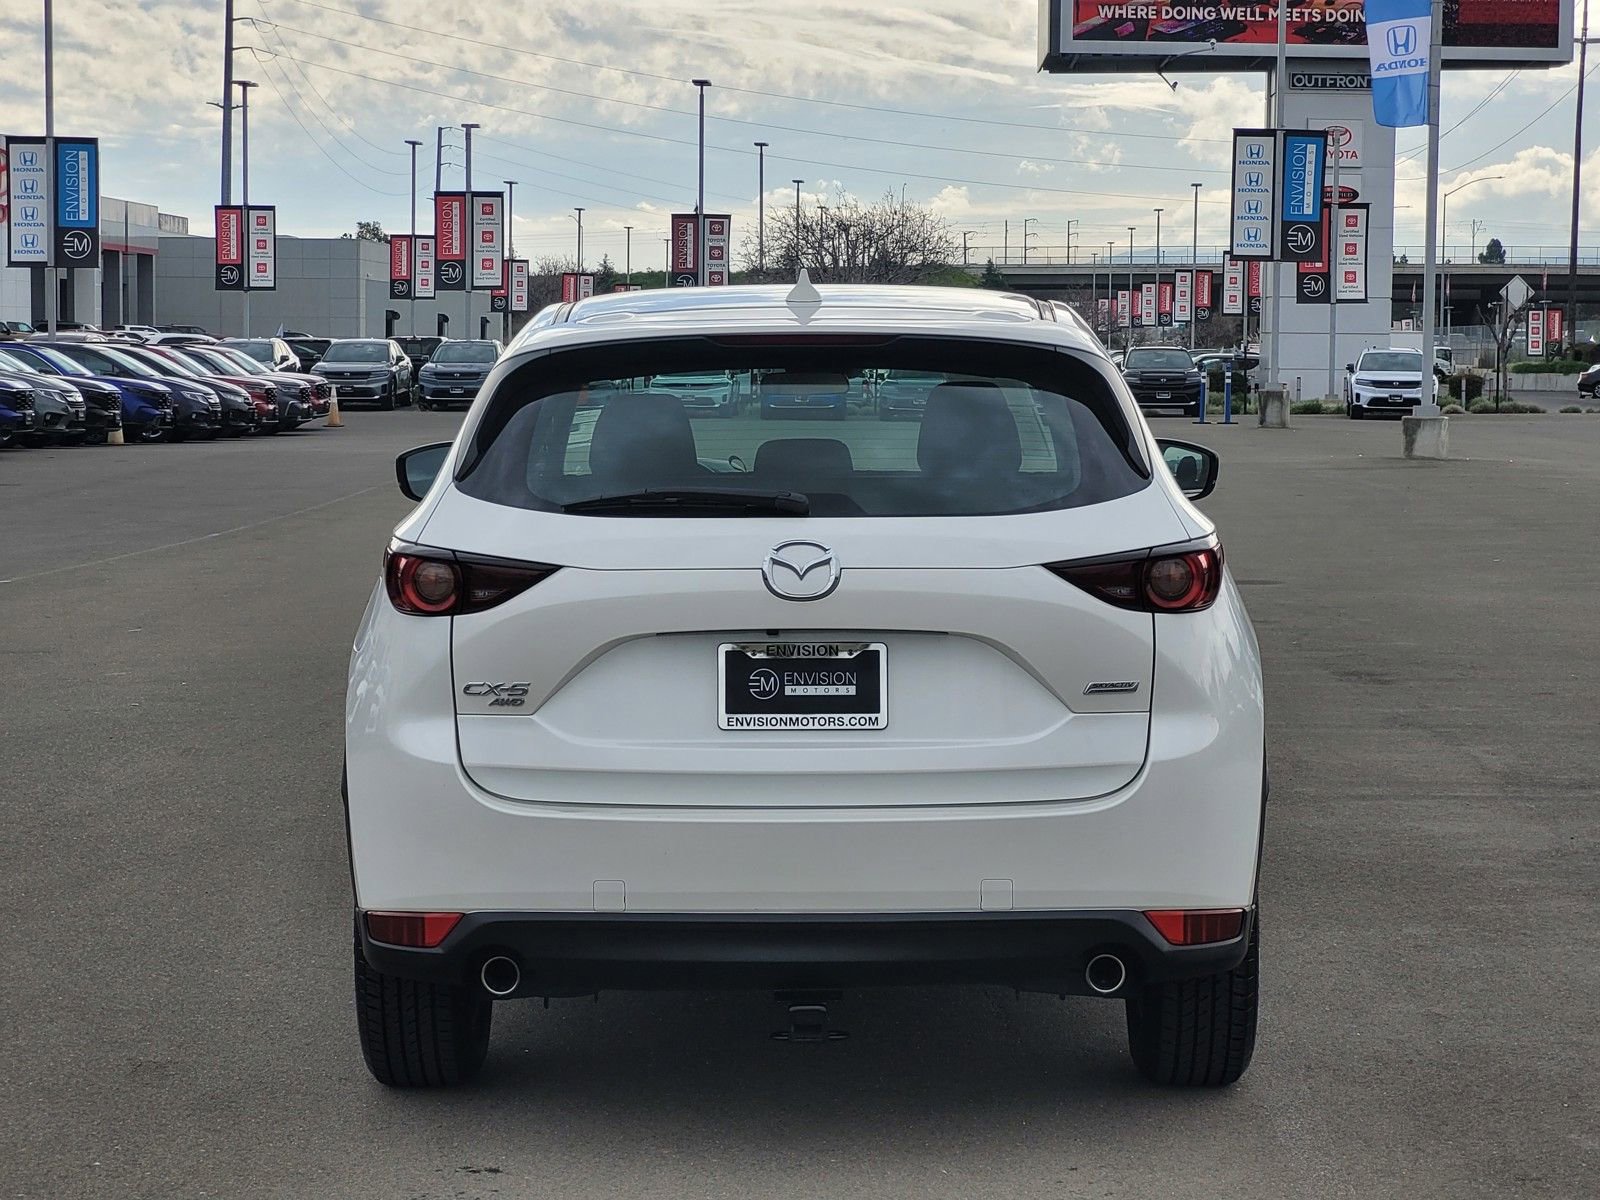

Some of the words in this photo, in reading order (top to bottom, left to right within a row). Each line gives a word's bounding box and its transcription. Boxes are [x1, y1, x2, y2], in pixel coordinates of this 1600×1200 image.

[1098, 5, 1157, 19] WHERE
[1162, 6, 1216, 20] DOING
[1220, 7, 1264, 21] WELL
[1326, 10, 1366, 22] DOIN
[1328, 150, 1358, 159] YOTA
[65, 150, 78, 221] ENVISION
[1290, 143, 1306, 215] ENVISION
[443, 202, 452, 255] ENVISION
[222, 214, 230, 260] ENVISION
[766, 645, 839, 656] ENVISION
[784, 672, 857, 685] ENVISION
[463, 682, 531, 696] CX-5
[488, 698, 525, 706] AWD
[727, 717, 879, 727] ENVISIONMOTORS.COM
